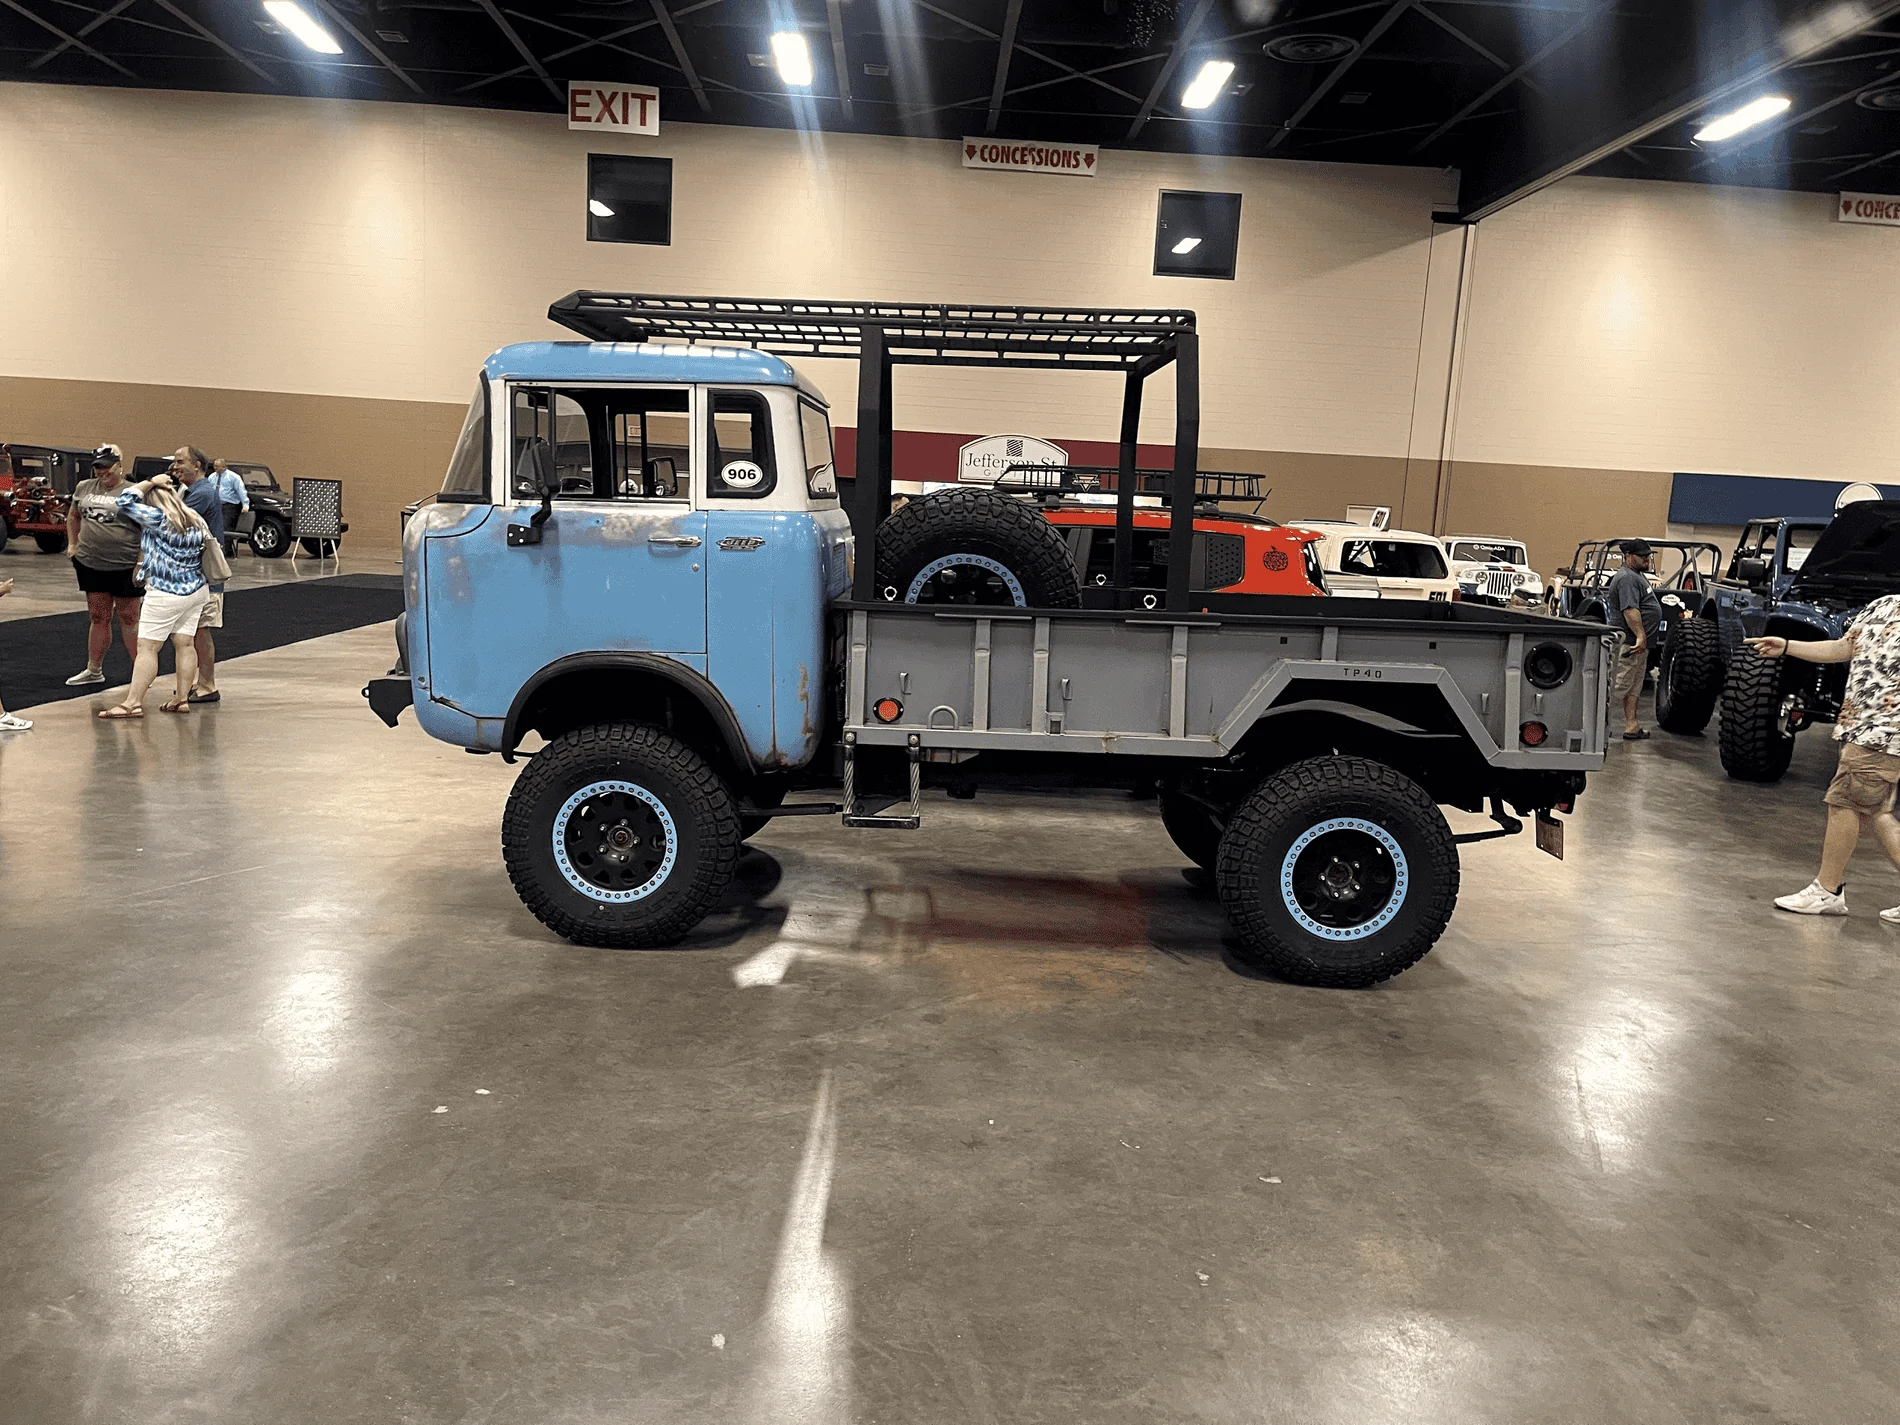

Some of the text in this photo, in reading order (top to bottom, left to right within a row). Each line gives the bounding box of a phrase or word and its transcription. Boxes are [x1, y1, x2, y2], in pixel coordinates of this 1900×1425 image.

[570, 89, 656, 126] EXIT
[980, 144, 1081, 169] CONCESSIONS
[728, 468, 757, 480] 906
[1343, 667, 1382, 679] TP40
